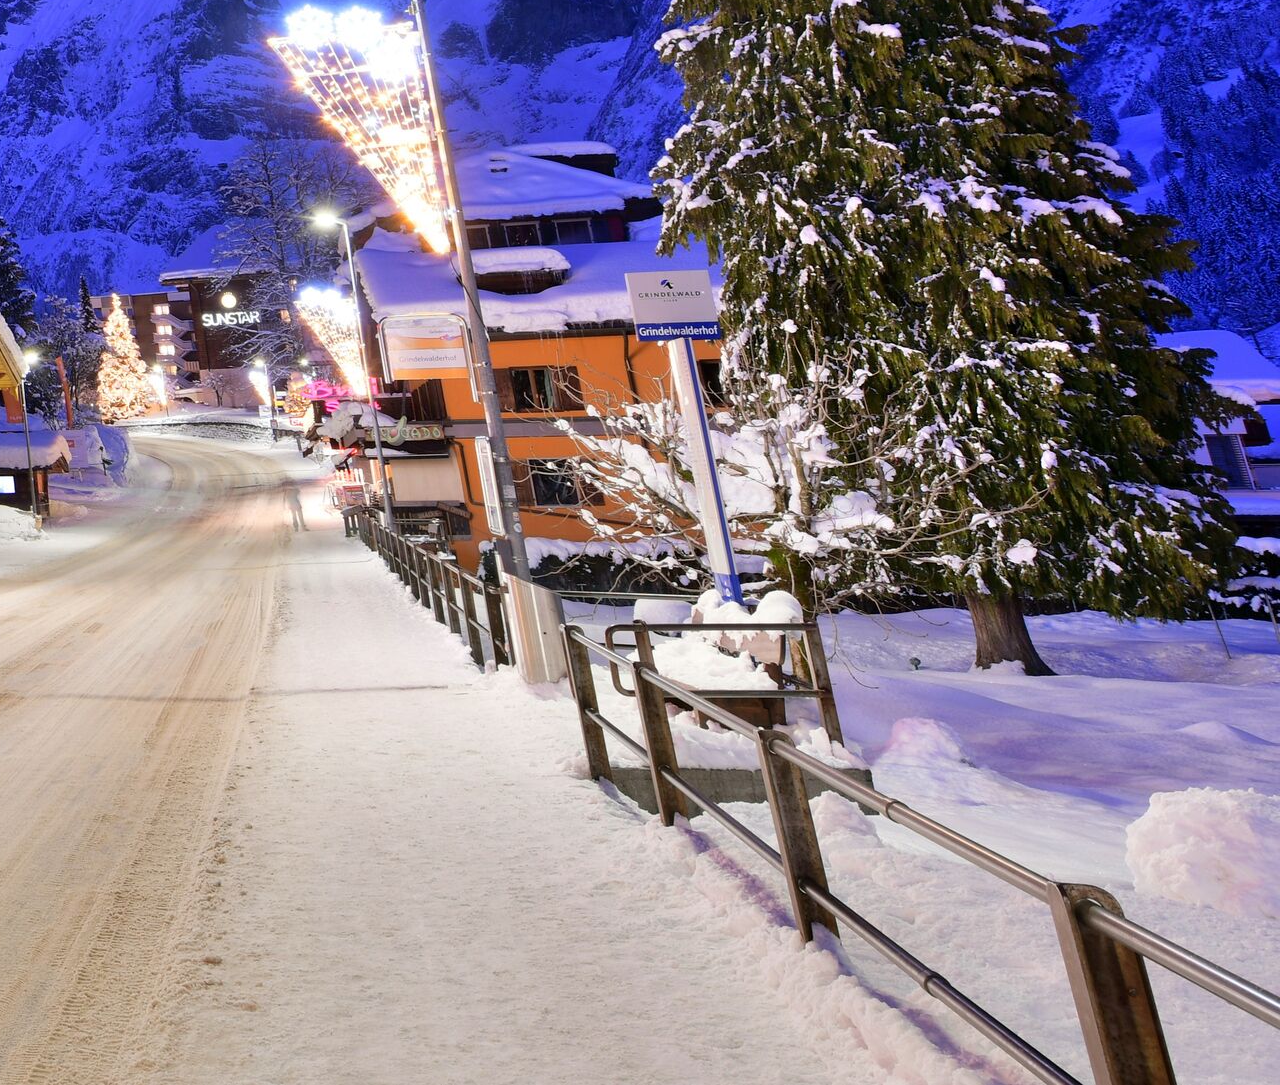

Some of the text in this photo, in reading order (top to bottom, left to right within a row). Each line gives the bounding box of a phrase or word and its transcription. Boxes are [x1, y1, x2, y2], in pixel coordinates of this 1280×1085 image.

[638, 290, 701, 299] GRINDELWALD
[201, 310, 260, 327] SUNSTAR
[639, 324, 718, 336] Grindelwalderhof
